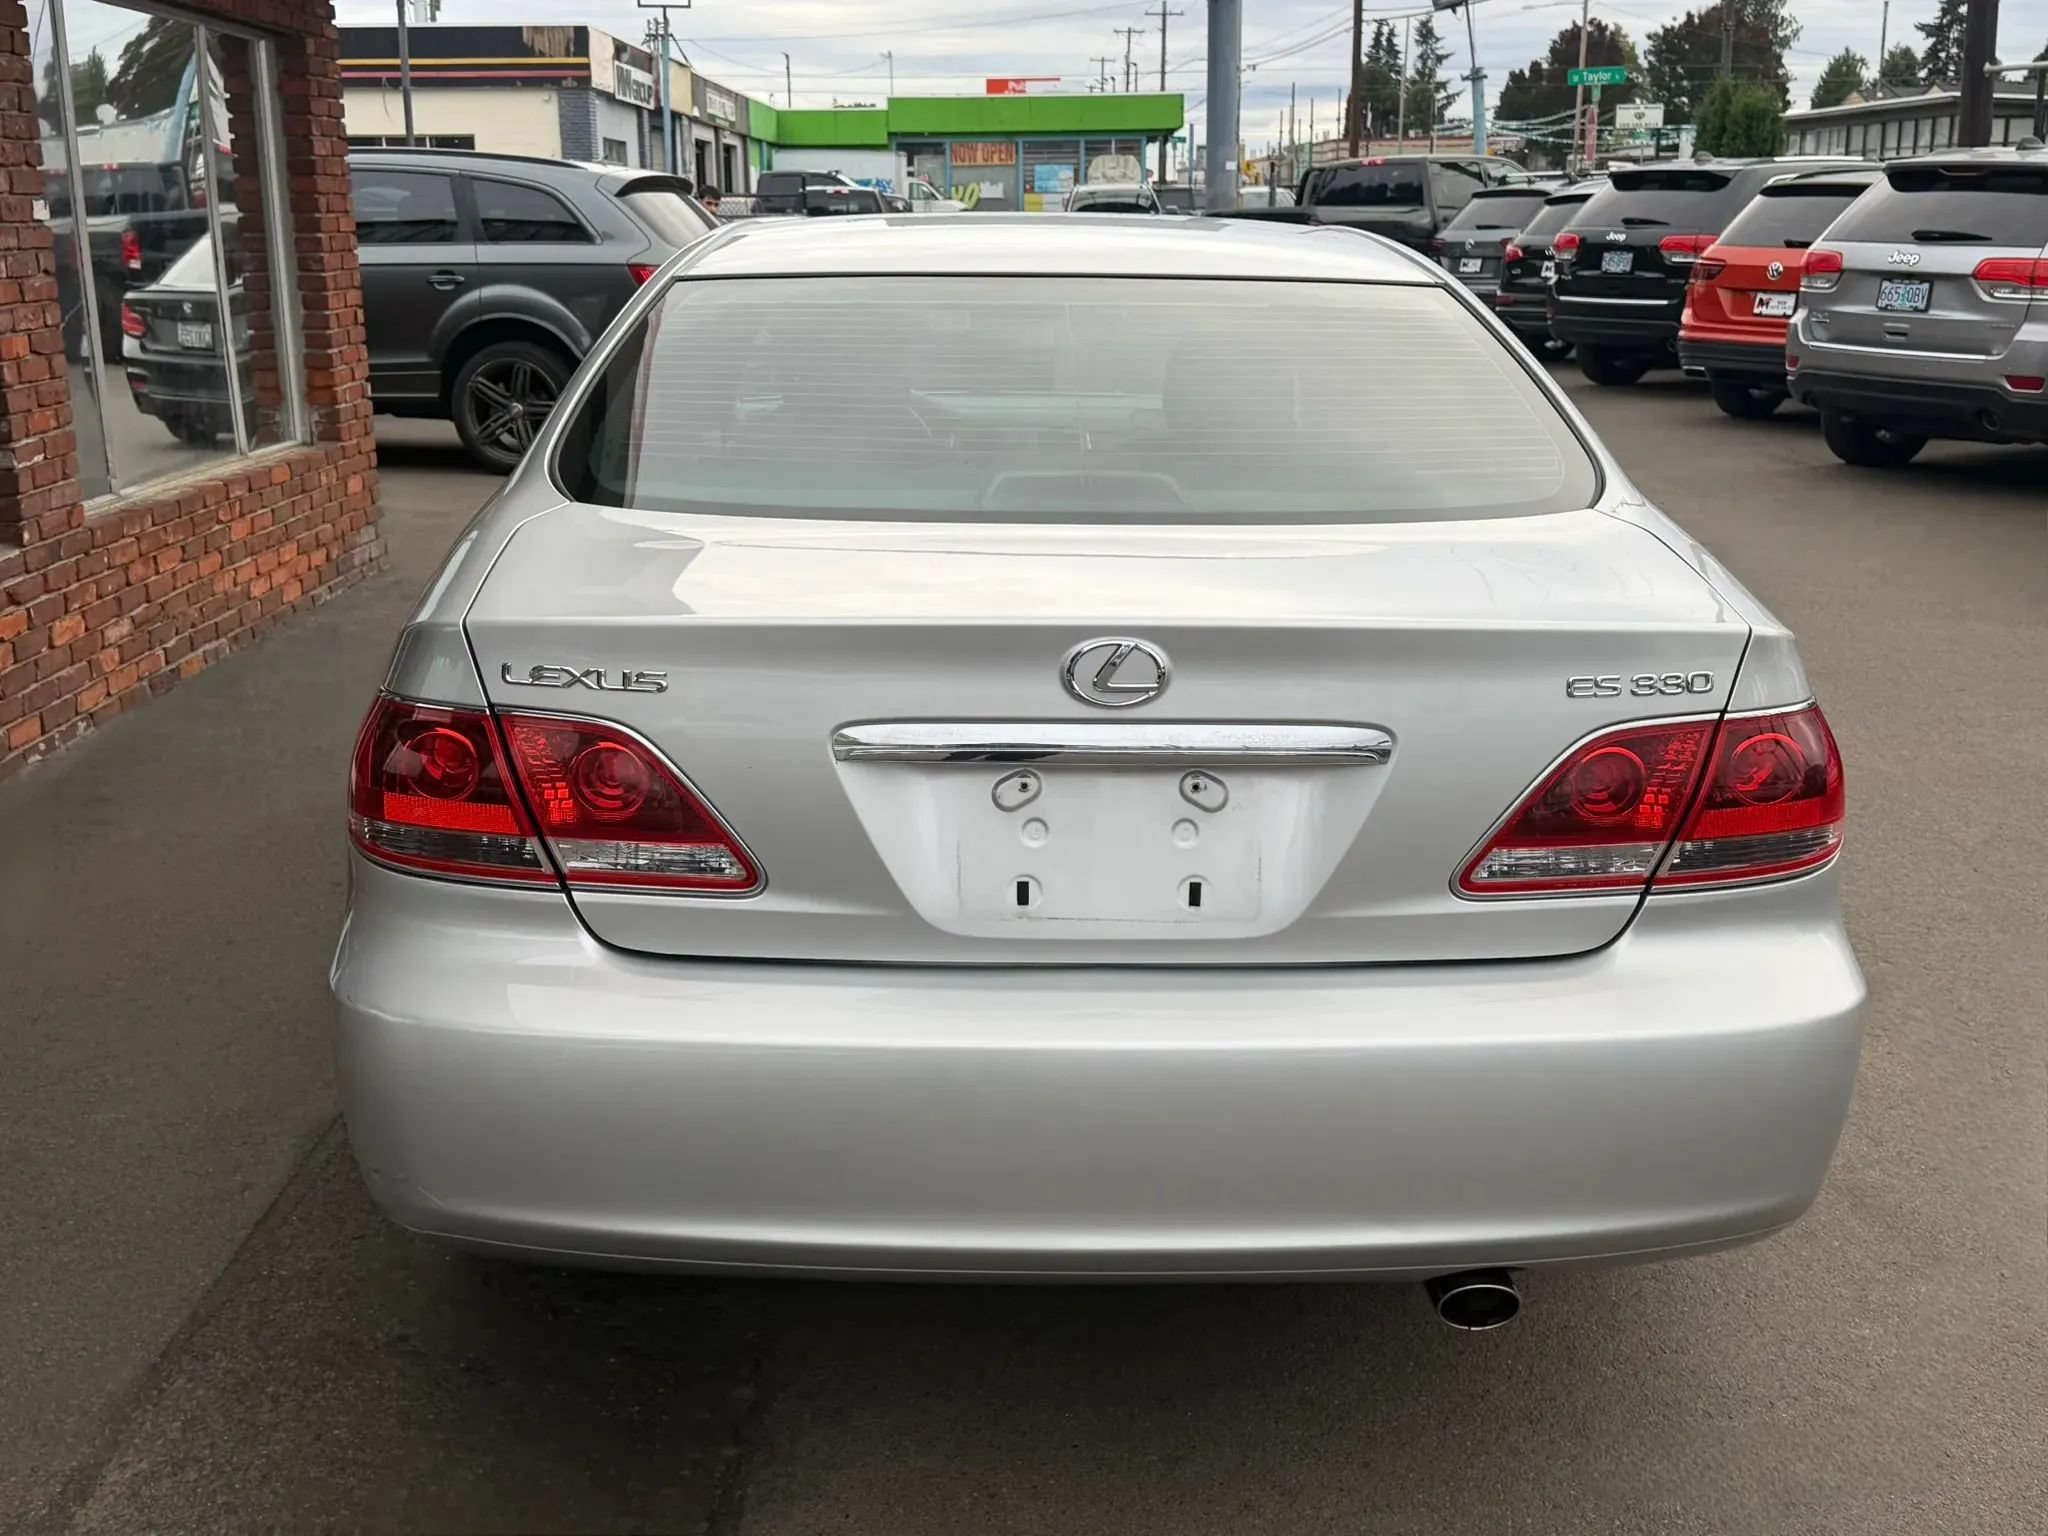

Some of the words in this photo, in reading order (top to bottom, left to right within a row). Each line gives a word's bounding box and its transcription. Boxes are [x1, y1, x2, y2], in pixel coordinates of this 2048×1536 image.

[1583, 71, 1612, 83] Taylor
[951, 143, 977, 163] NOW
[982, 143, 1015, 163] OPEN
[1606, 231, 1627, 244] Jeep
[1888, 250, 1921, 267] Jeep
[1879, 286, 1902, 302] 665
[502, 662, 669, 694] LEXUS
[1566, 674, 1623, 698] ES
[1630, 670, 1715, 697] 330
